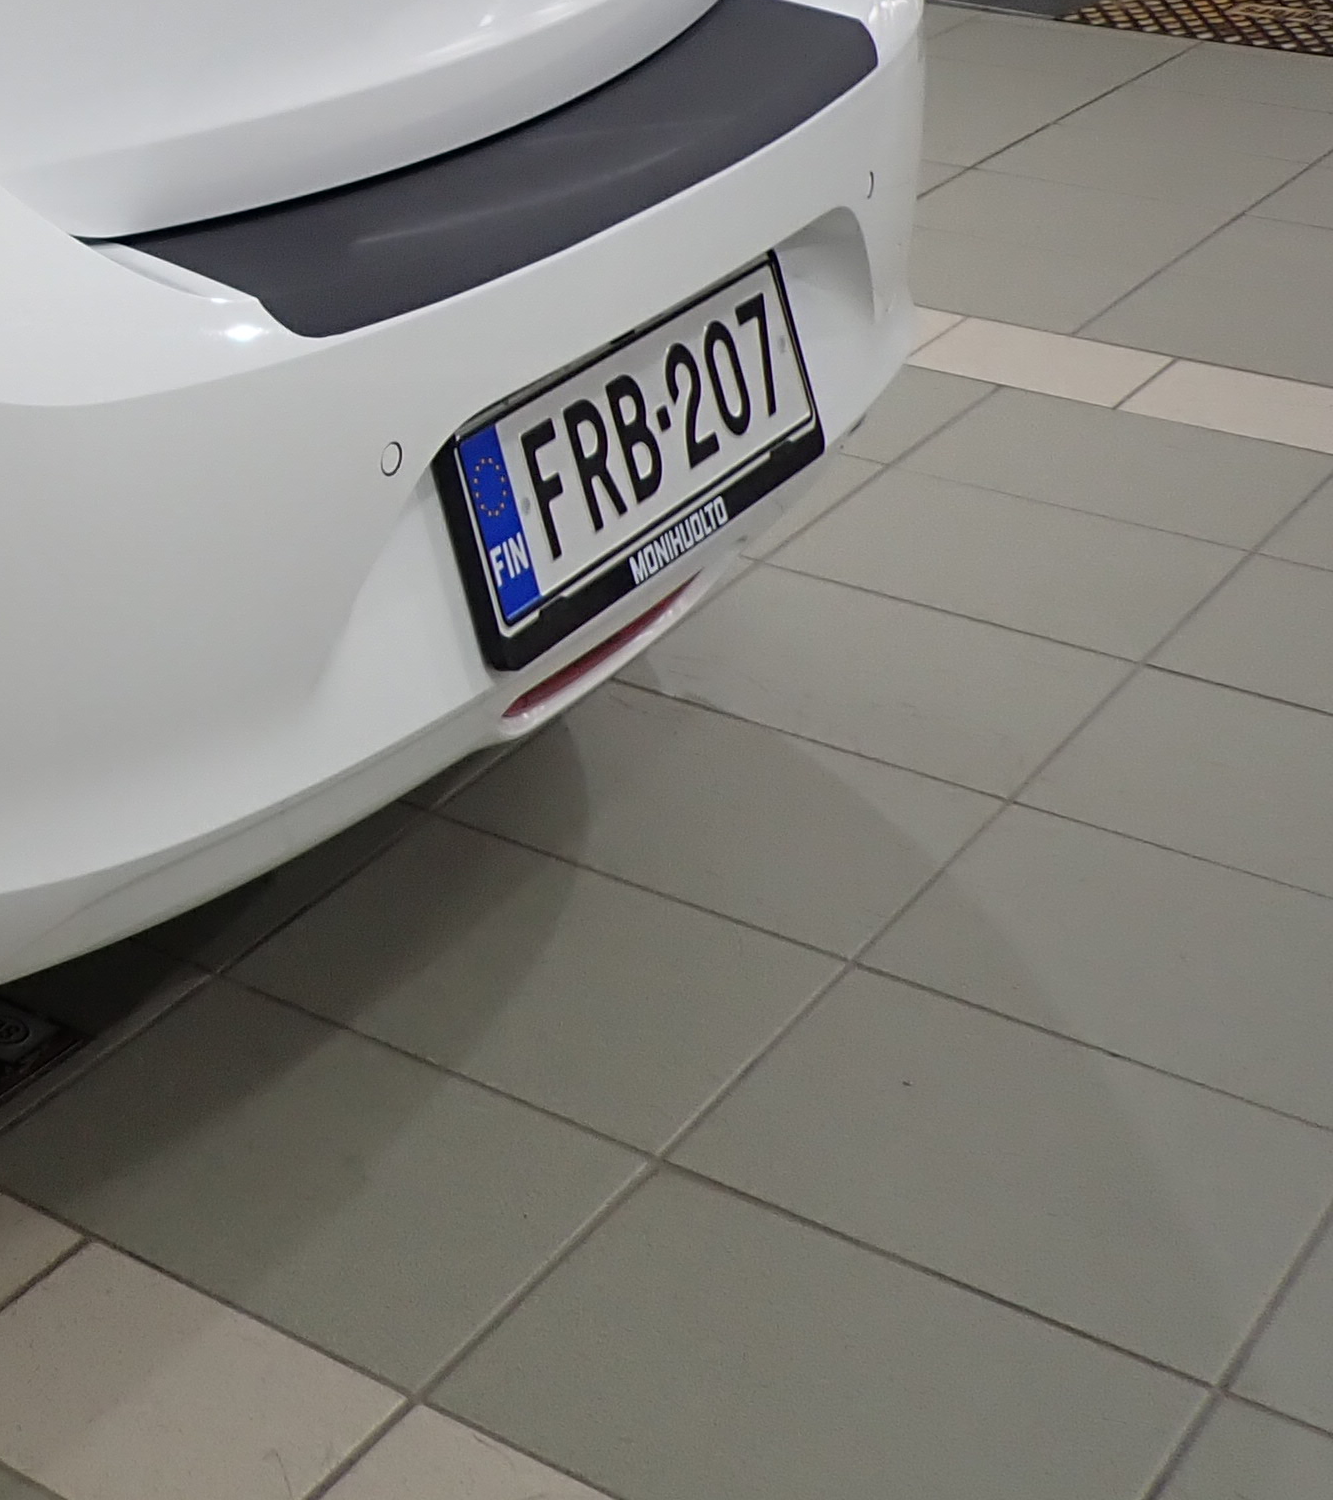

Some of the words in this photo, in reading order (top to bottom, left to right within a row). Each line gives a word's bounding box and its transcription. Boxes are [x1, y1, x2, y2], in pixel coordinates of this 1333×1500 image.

[520, 292, 777, 560] FRB-207
[490, 532, 530, 588] FIN
[629, 495, 729, 585] MONIHUOLTO
